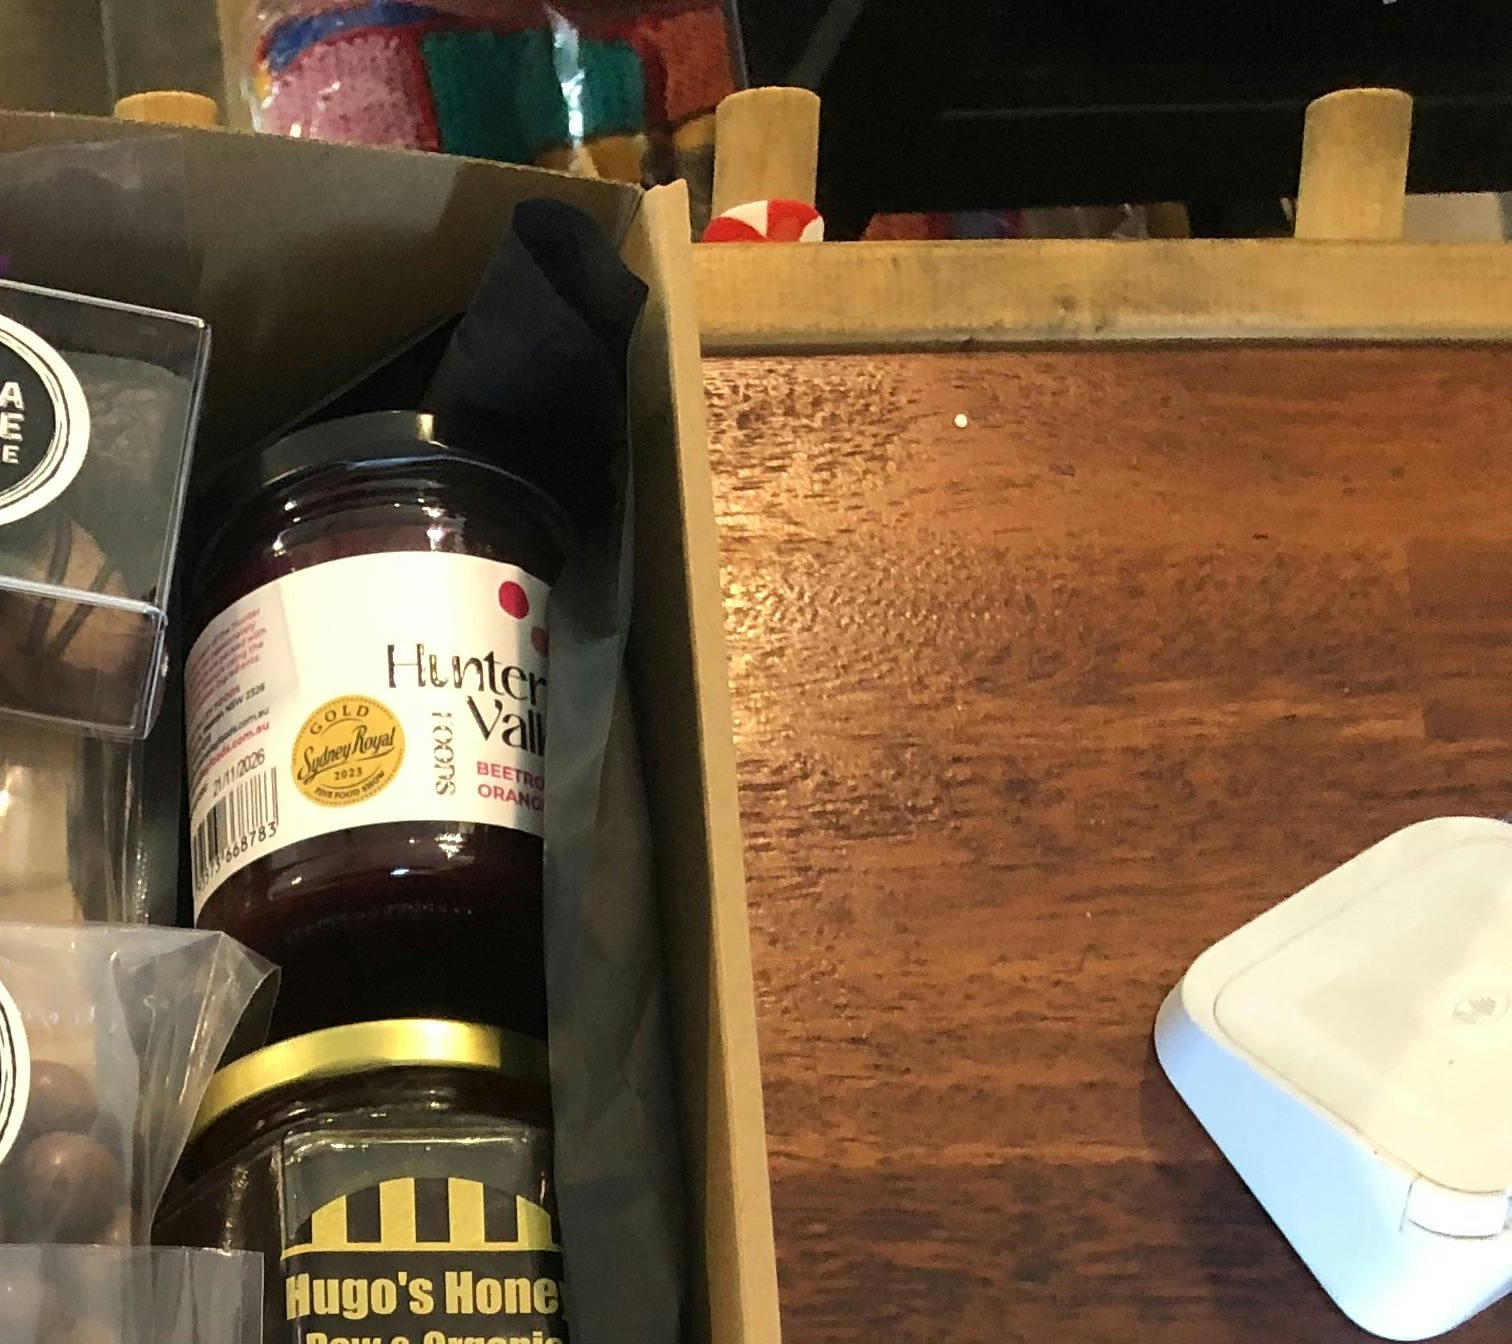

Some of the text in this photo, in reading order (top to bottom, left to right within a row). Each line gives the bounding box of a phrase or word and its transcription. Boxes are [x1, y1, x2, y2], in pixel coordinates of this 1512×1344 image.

[386, 642, 548, 707] Hunter
[309, 703, 370, 736] GOLD
[465, 695, 547, 757] Vall
[296, 724, 397, 786] Sydney Royal
[334, 766, 363, 781] 2023
[285, 1270, 560, 1321] Hugo's Hone
